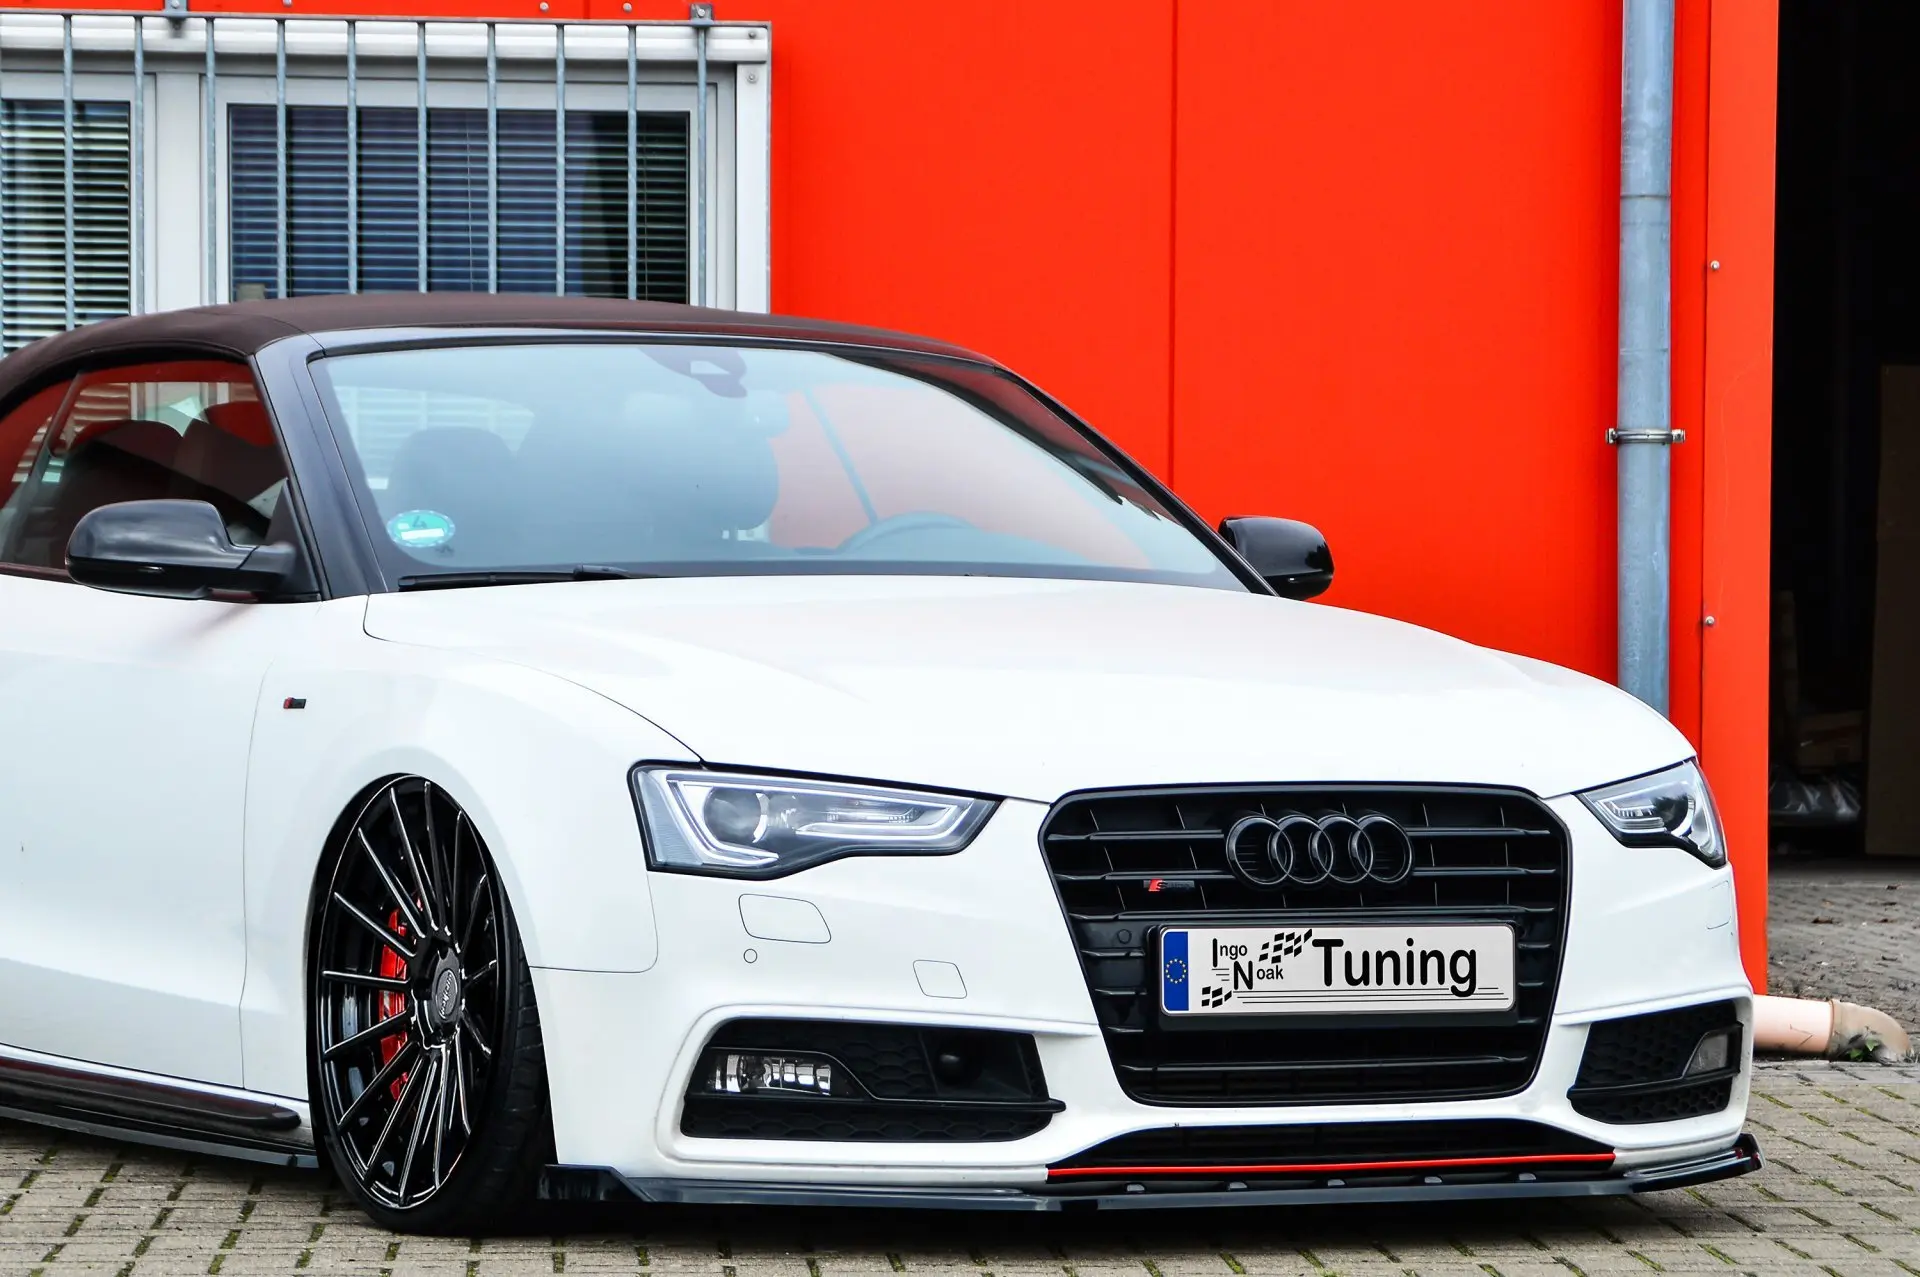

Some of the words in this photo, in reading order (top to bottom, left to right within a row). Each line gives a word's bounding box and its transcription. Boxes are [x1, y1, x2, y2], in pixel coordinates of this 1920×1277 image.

[1212, 938, 1248, 968] Ingo
[1311, 938, 1477, 998] Tuning
[1233, 960, 1285, 991] Noak
